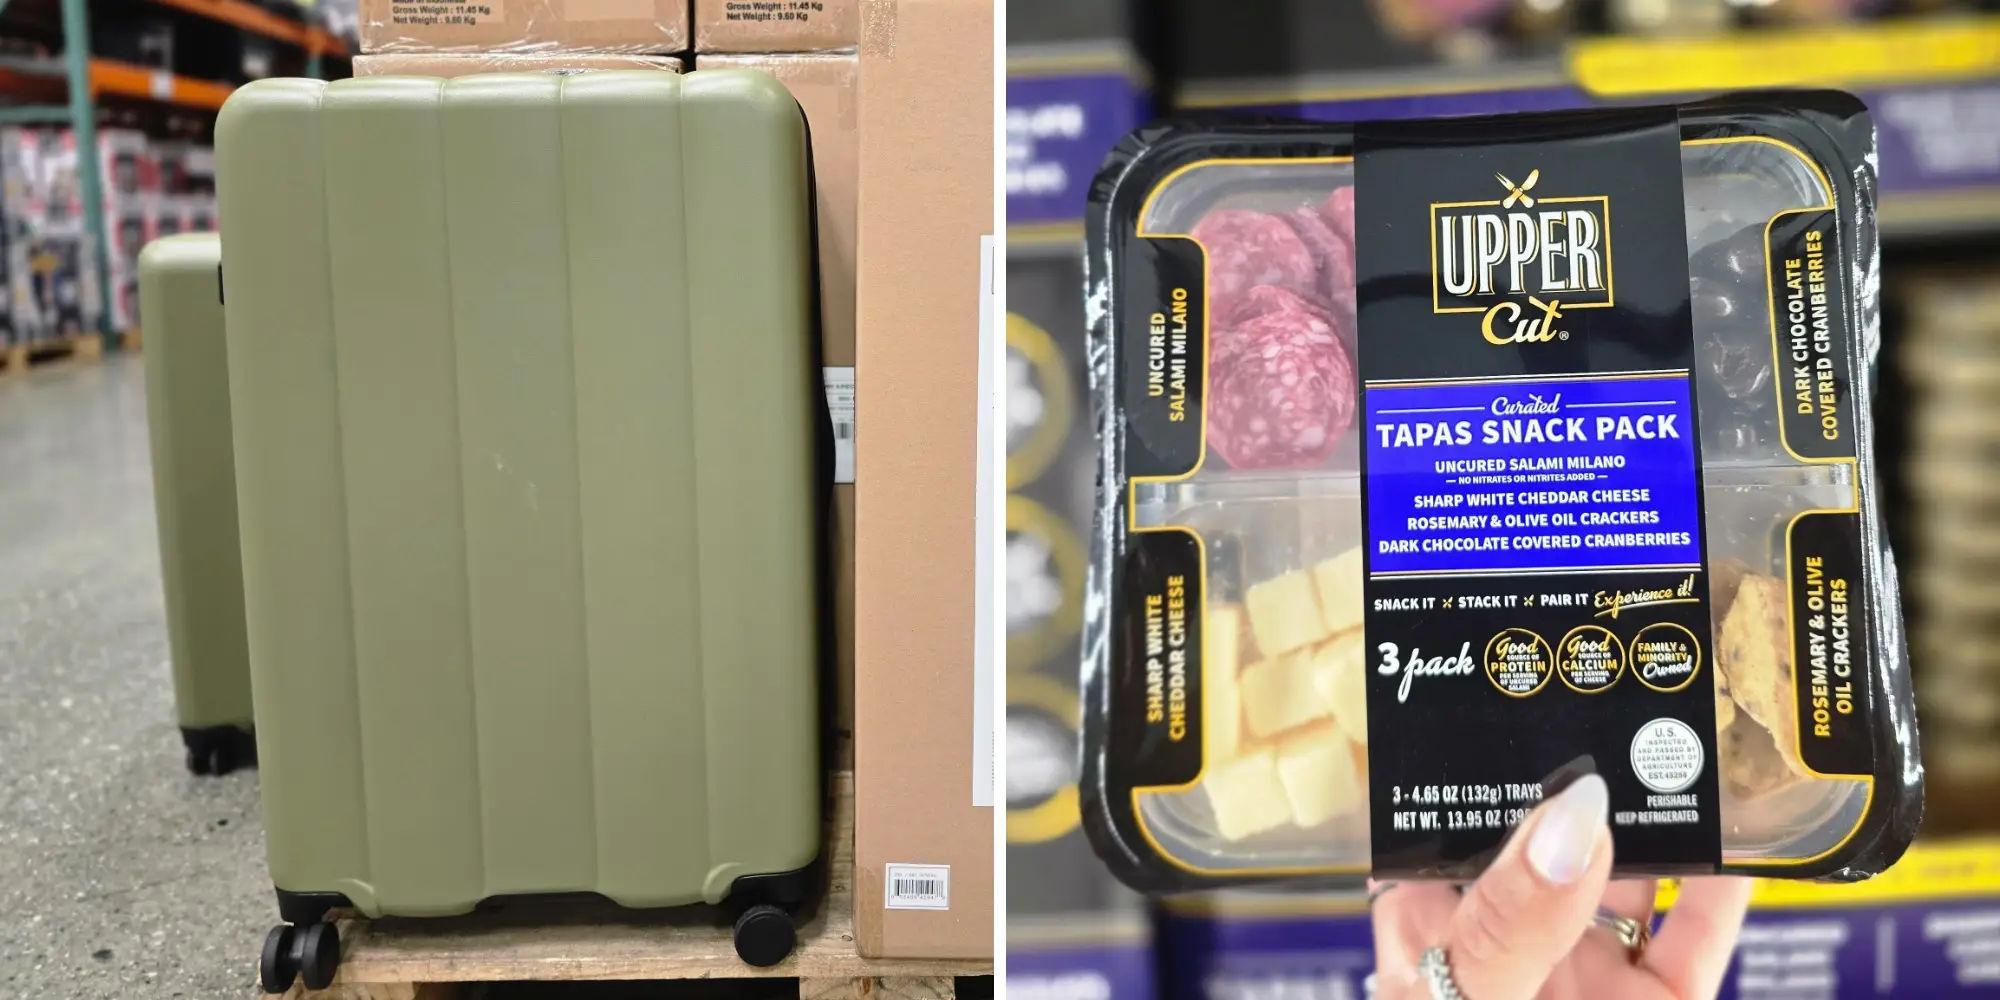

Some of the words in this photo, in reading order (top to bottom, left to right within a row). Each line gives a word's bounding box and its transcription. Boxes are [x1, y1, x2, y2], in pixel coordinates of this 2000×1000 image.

[478, 6, 490, 15] Kg
[727, 2, 751, 10] Gross
[753, 2, 781, 11] Weight
[811, 2, 823, 11] Kg
[727, 12, 740, 20] Net
[742, 12, 771, 22] Weight
[796, 12, 808, 21] Kg
[1441, 210, 1606, 297] UPPER
[1806, 230, 1831, 354] CRANBERRIES
[1170, 287, 1188, 355] MILANO
[1785, 257, 1810, 362] CHOCOLATE
[1148, 312, 1166, 397] UNCURED
[1169, 358, 1187, 422] SALAMI
[1491, 393, 1561, 416] Curated
[1795, 365, 1814, 414] DARK
[1816, 357, 1839, 441] COVERED
[1375, 420, 1473, 448] TAPAS
[1482, 417, 1588, 444] SNACK
[1596, 414, 1680, 441] PACK
[1435, 459, 1506, 474] UNCURED
[1509, 457, 1563, 471] SALAMI
[1567, 455, 1626, 469] MILANO
[1458, 476, 1471, 484] NO
[1472, 475, 1512, 484] NITRATES
[1513, 474, 1526, 483] OR
[1527, 473, 1566, 483] NITRITES
[1567, 472, 1596, 481] ADDED
[1414, 494, 1463, 508] SHARP
[1466, 493, 1514, 507] WHITE
[1518, 491, 1589, 505] CHEDDAR
[1591, 488, 1650, 503] CHEESE
[1407, 515, 1488, 530] ROSEMARY
[1490, 515, 1502, 528] &
[1504, 513, 1549, 527] OLIVE
[1552, 512, 1577, 526] OIL
[1580, 510, 1659, 525] CRACKERS
[1379, 539, 1419, 554] DARK
[1422, 536, 1509, 552] CHOCOLATE
[1513, 534, 1581, 549] COVERED
[1584, 532, 1691, 547] CRANBERRIES
[1374, 598, 1419, 611] SNACK
[1422, 597, 1436, 609] IT
[1458, 595, 1501, 608] STACK
[1504, 595, 1517, 608] IT
[1540, 594, 1572, 606] PAIR
[1575, 593, 1588, 605] IT
[1593, 588, 1673, 619] Experience
[1677, 573, 1695, 597] it!
[1806, 555, 1826, 612] OLIVE
[1145, 593, 1164, 657] WHITE
[1167, 574, 1186, 647] CHEESE
[1808, 614, 1826, 631] &
[1830, 578, 1851, 678] CRACKERS
[1637, 642, 1677, 653] FAMILY
[1678, 643, 1687, 652] &
[1637, 652, 1687, 663] MINORITY
[1377, 641, 1400, 676] 3
[1397, 641, 1475, 704] pack
[1490, 661, 1546, 673] PROTEIN
[1562, 659, 1618, 671] CALCIUM
[1642, 654, 1692, 680] Owned
[1146, 657, 1164, 723] SHARP
[1168, 649, 1186, 742] CHEDDAR
[1809, 632, 1832, 737] ROSEMARY
[1836, 681, 1854, 715] OIL
[1392, 785, 1401, 805] 3
[1412, 785, 1439, 805] 4.65
[1442, 785, 1459, 804] OZ
[1461, 784, 1502, 806] (132g)
[1505, 783, 1543, 801] TRAYS
[1646, 794, 1698, 808] PERISHABLE
[1393, 811, 1417, 831] NET
[1419, 810, 1441, 830] WT.
[1447, 810, 1482, 829] 13.95
[1485, 809, 1501, 827] OZ
[1615, 811, 1637, 825] KEEP
[1637, 809, 1699, 823] REFRIGERATED
